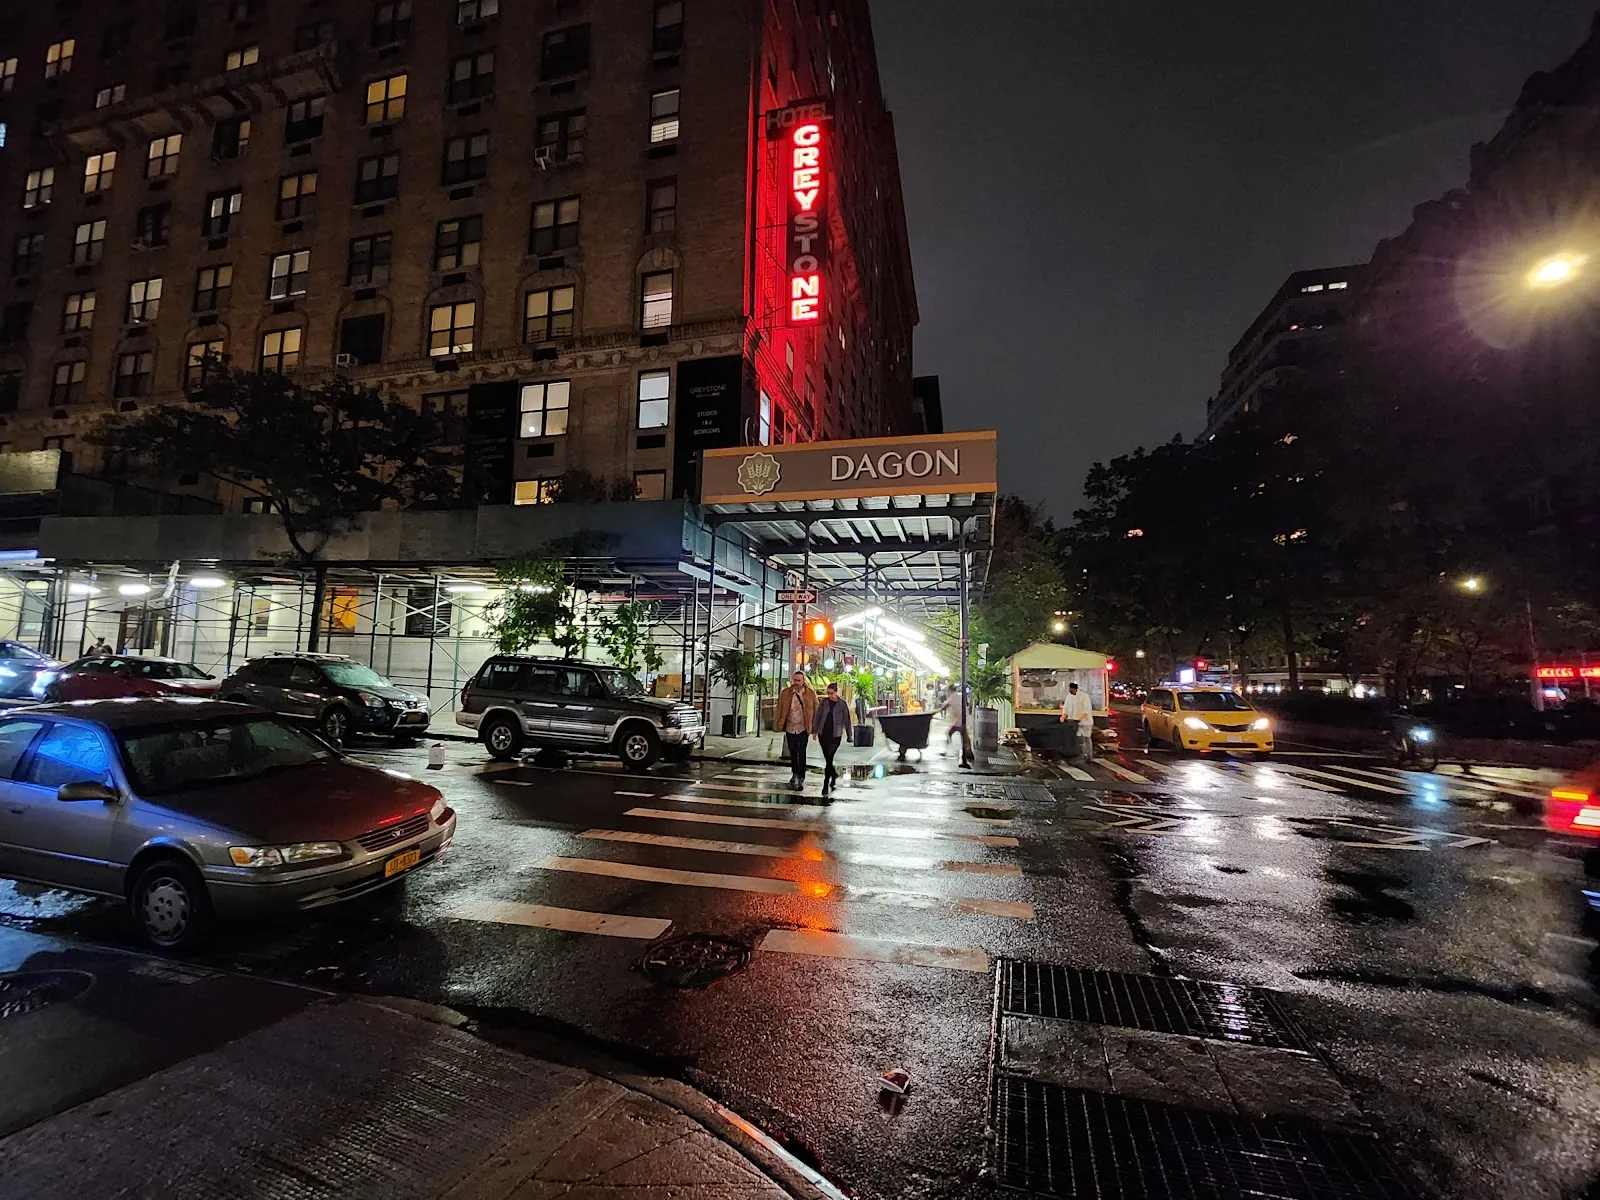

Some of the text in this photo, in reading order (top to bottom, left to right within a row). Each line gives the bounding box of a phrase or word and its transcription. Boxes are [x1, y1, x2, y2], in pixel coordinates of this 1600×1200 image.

[767, 104, 834, 128] HOTEL
[792, 125, 820, 321] GREYSTONE
[831, 448, 960, 482] DAGON
